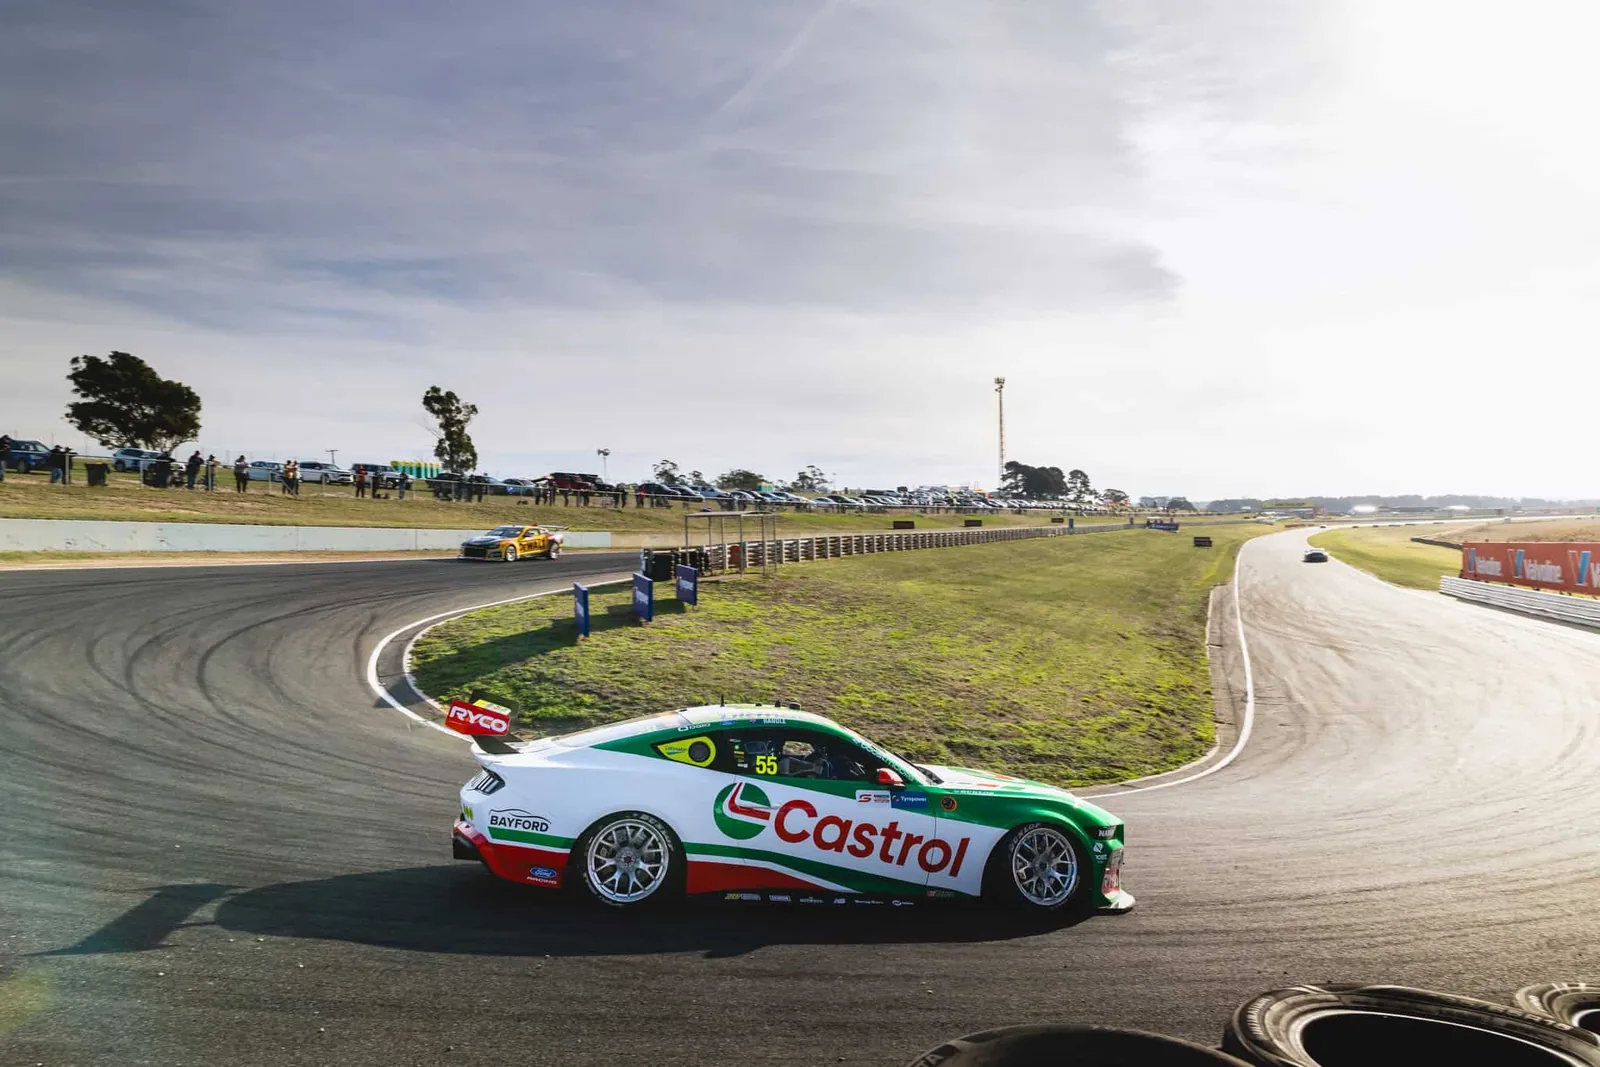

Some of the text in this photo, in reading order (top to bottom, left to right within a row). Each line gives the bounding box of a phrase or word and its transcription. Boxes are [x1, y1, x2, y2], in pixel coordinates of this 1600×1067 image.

[449, 705, 507, 733] RYCO
[755, 755, 778, 775] 55
[489, 815, 549, 832] BAYFORD
[774, 799, 971, 878] Castrol
